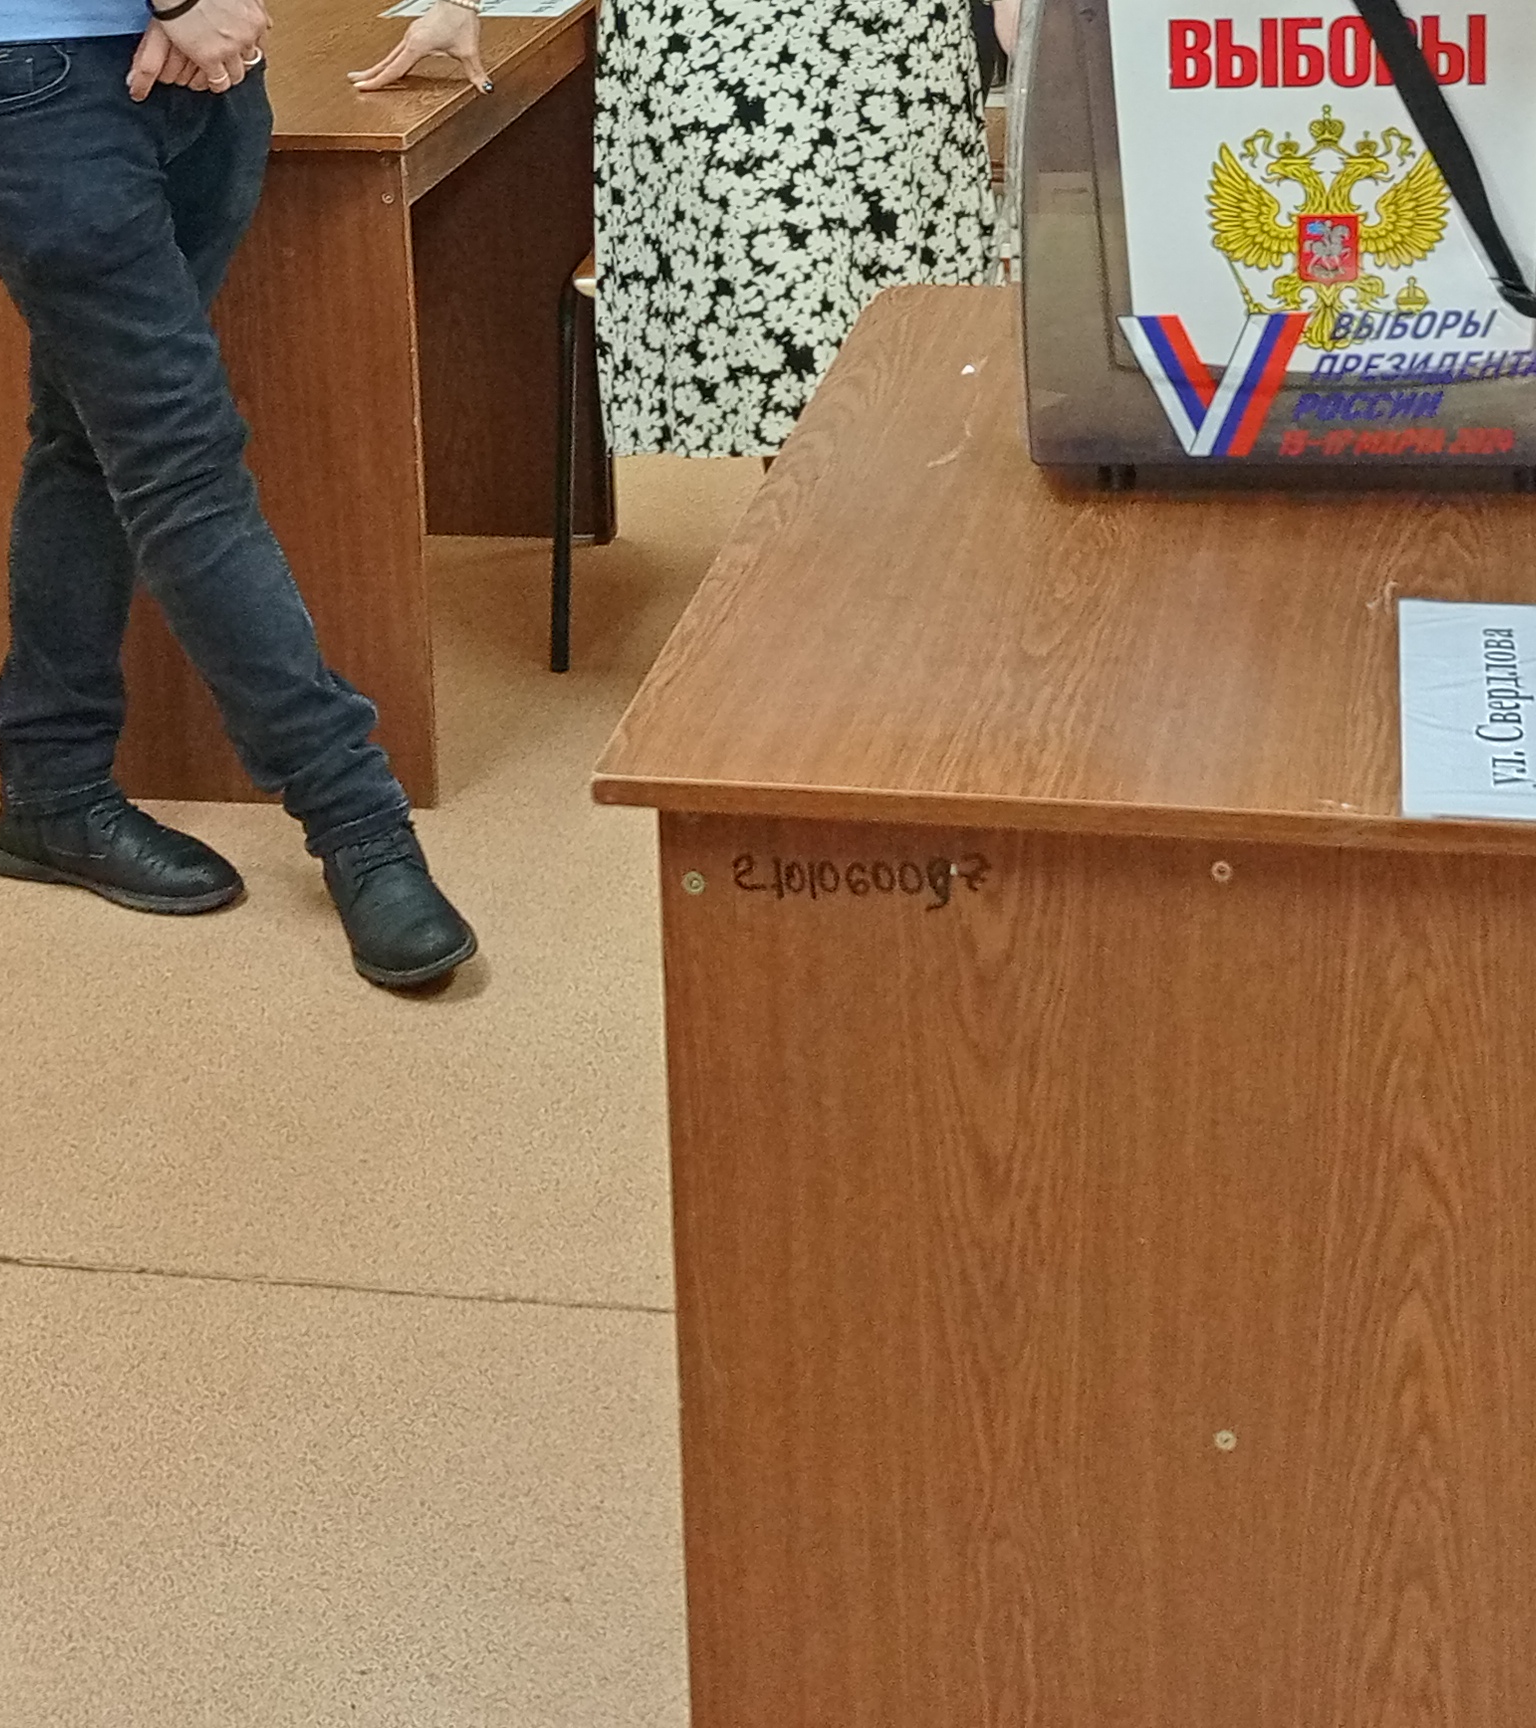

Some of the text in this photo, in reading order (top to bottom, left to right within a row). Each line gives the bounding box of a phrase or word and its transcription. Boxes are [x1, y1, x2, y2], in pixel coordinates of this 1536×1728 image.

[1330, 309, 1498, 341] ВЫБОРЫ
[1292, 390, 1444, 421] РОССИИ
[1476, 627, 1535, 743] Свердлова
